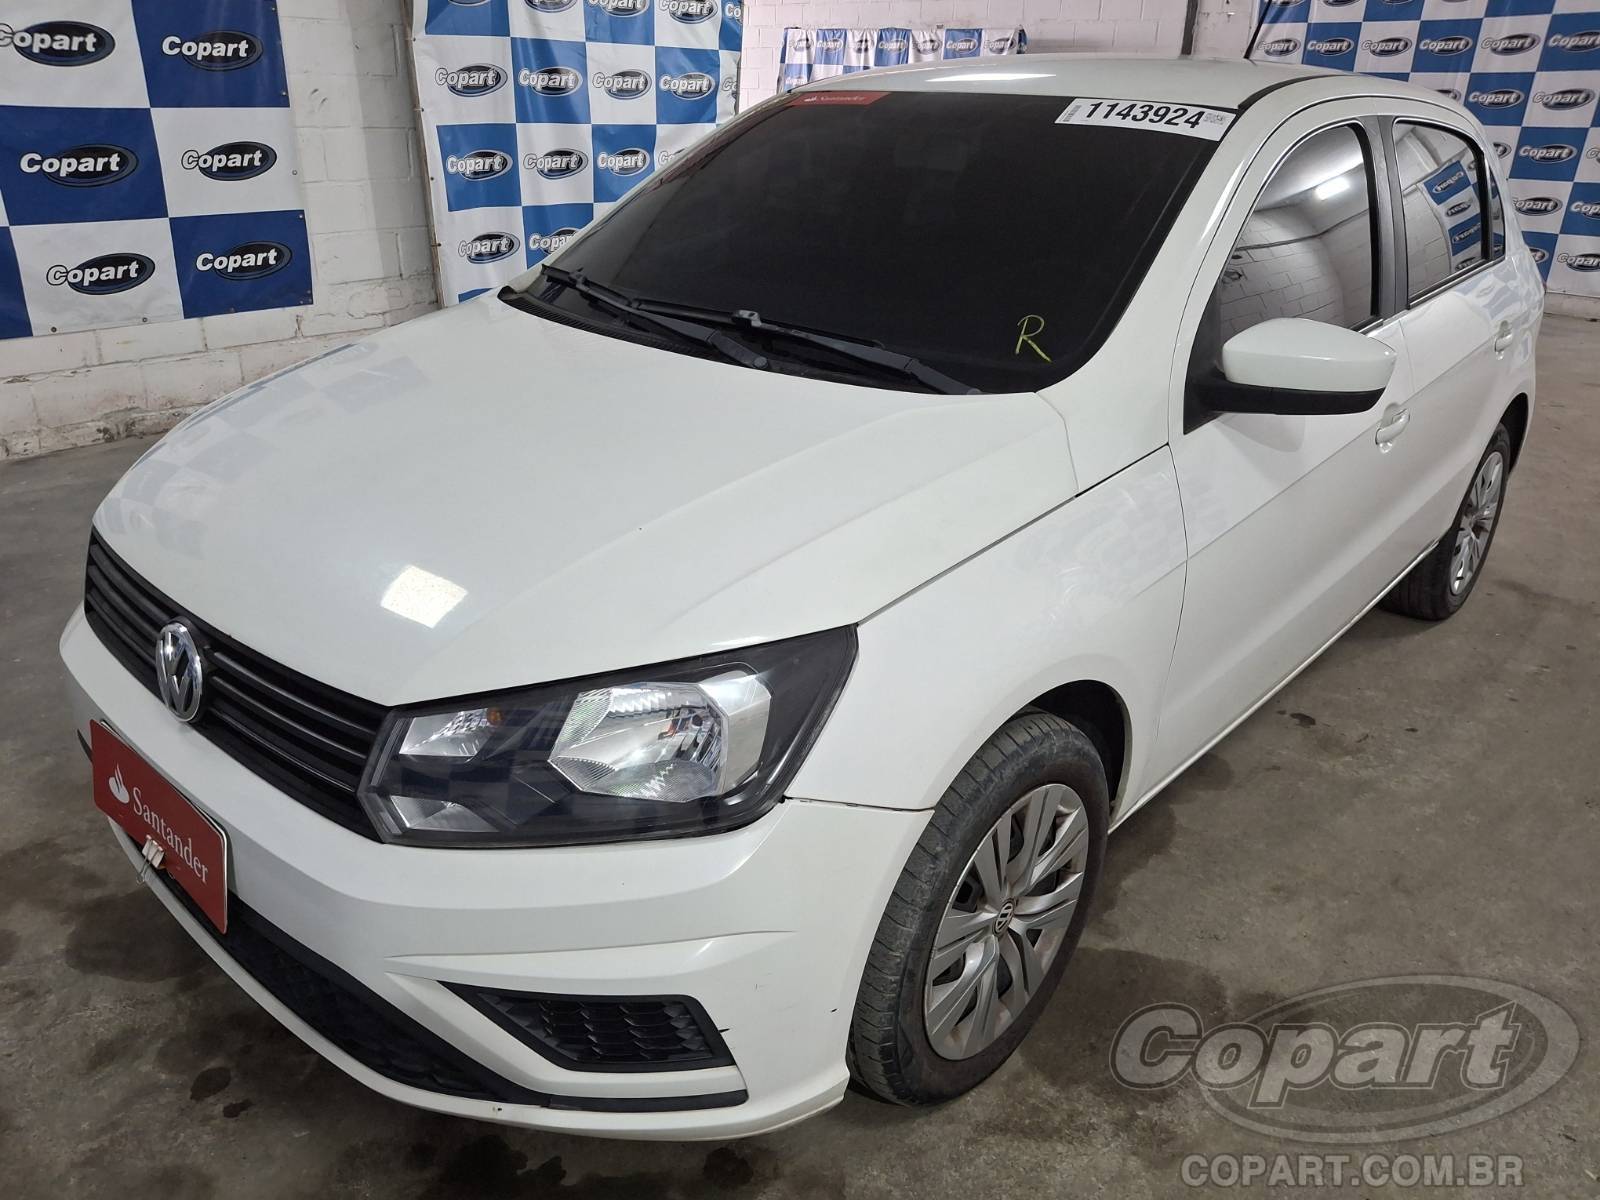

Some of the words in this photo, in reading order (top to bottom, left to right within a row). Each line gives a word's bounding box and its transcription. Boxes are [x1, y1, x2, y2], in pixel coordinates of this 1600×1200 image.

[659, 0, 713, 15] Copart
[0, 25, 97, 52] Copart
[162, 35, 249, 60] Copart
[946, 40, 974, 52] Copart
[1258, 39, 1295, 52] Copart
[1307, 39, 1349, 53] Copart
[1362, 39, 1407, 53] Copart
[1420, 38, 1466, 52] Copart
[1481, 36, 1531, 51] Copart
[435, 67, 497, 89] Copart
[519, 69, 575, 90] Copart
[593, 72, 646, 91] Copart
[660, 75, 710, 92] Copart
[1469, 91, 1518, 108] Copart
[1533, 89, 1586, 107] Copart
[1086, 101, 1205, 128] 1143924
[181, 148, 262, 171] Copart
[524, 151, 580, 173] Copart
[597, 152, 643, 170] Copart
[1519, 145, 1570, 161] Copart
[20, 152, 120, 176] Copart
[447, 155, 503, 177] Copart
[458, 236, 510, 258] Copart
[196, 247, 278, 272] Copart
[1557, 252, 1600, 268] Copar
[47, 260, 139, 286] Copart
[1015, 314, 1052, 362] R
[132, 787, 208, 885] Santander
